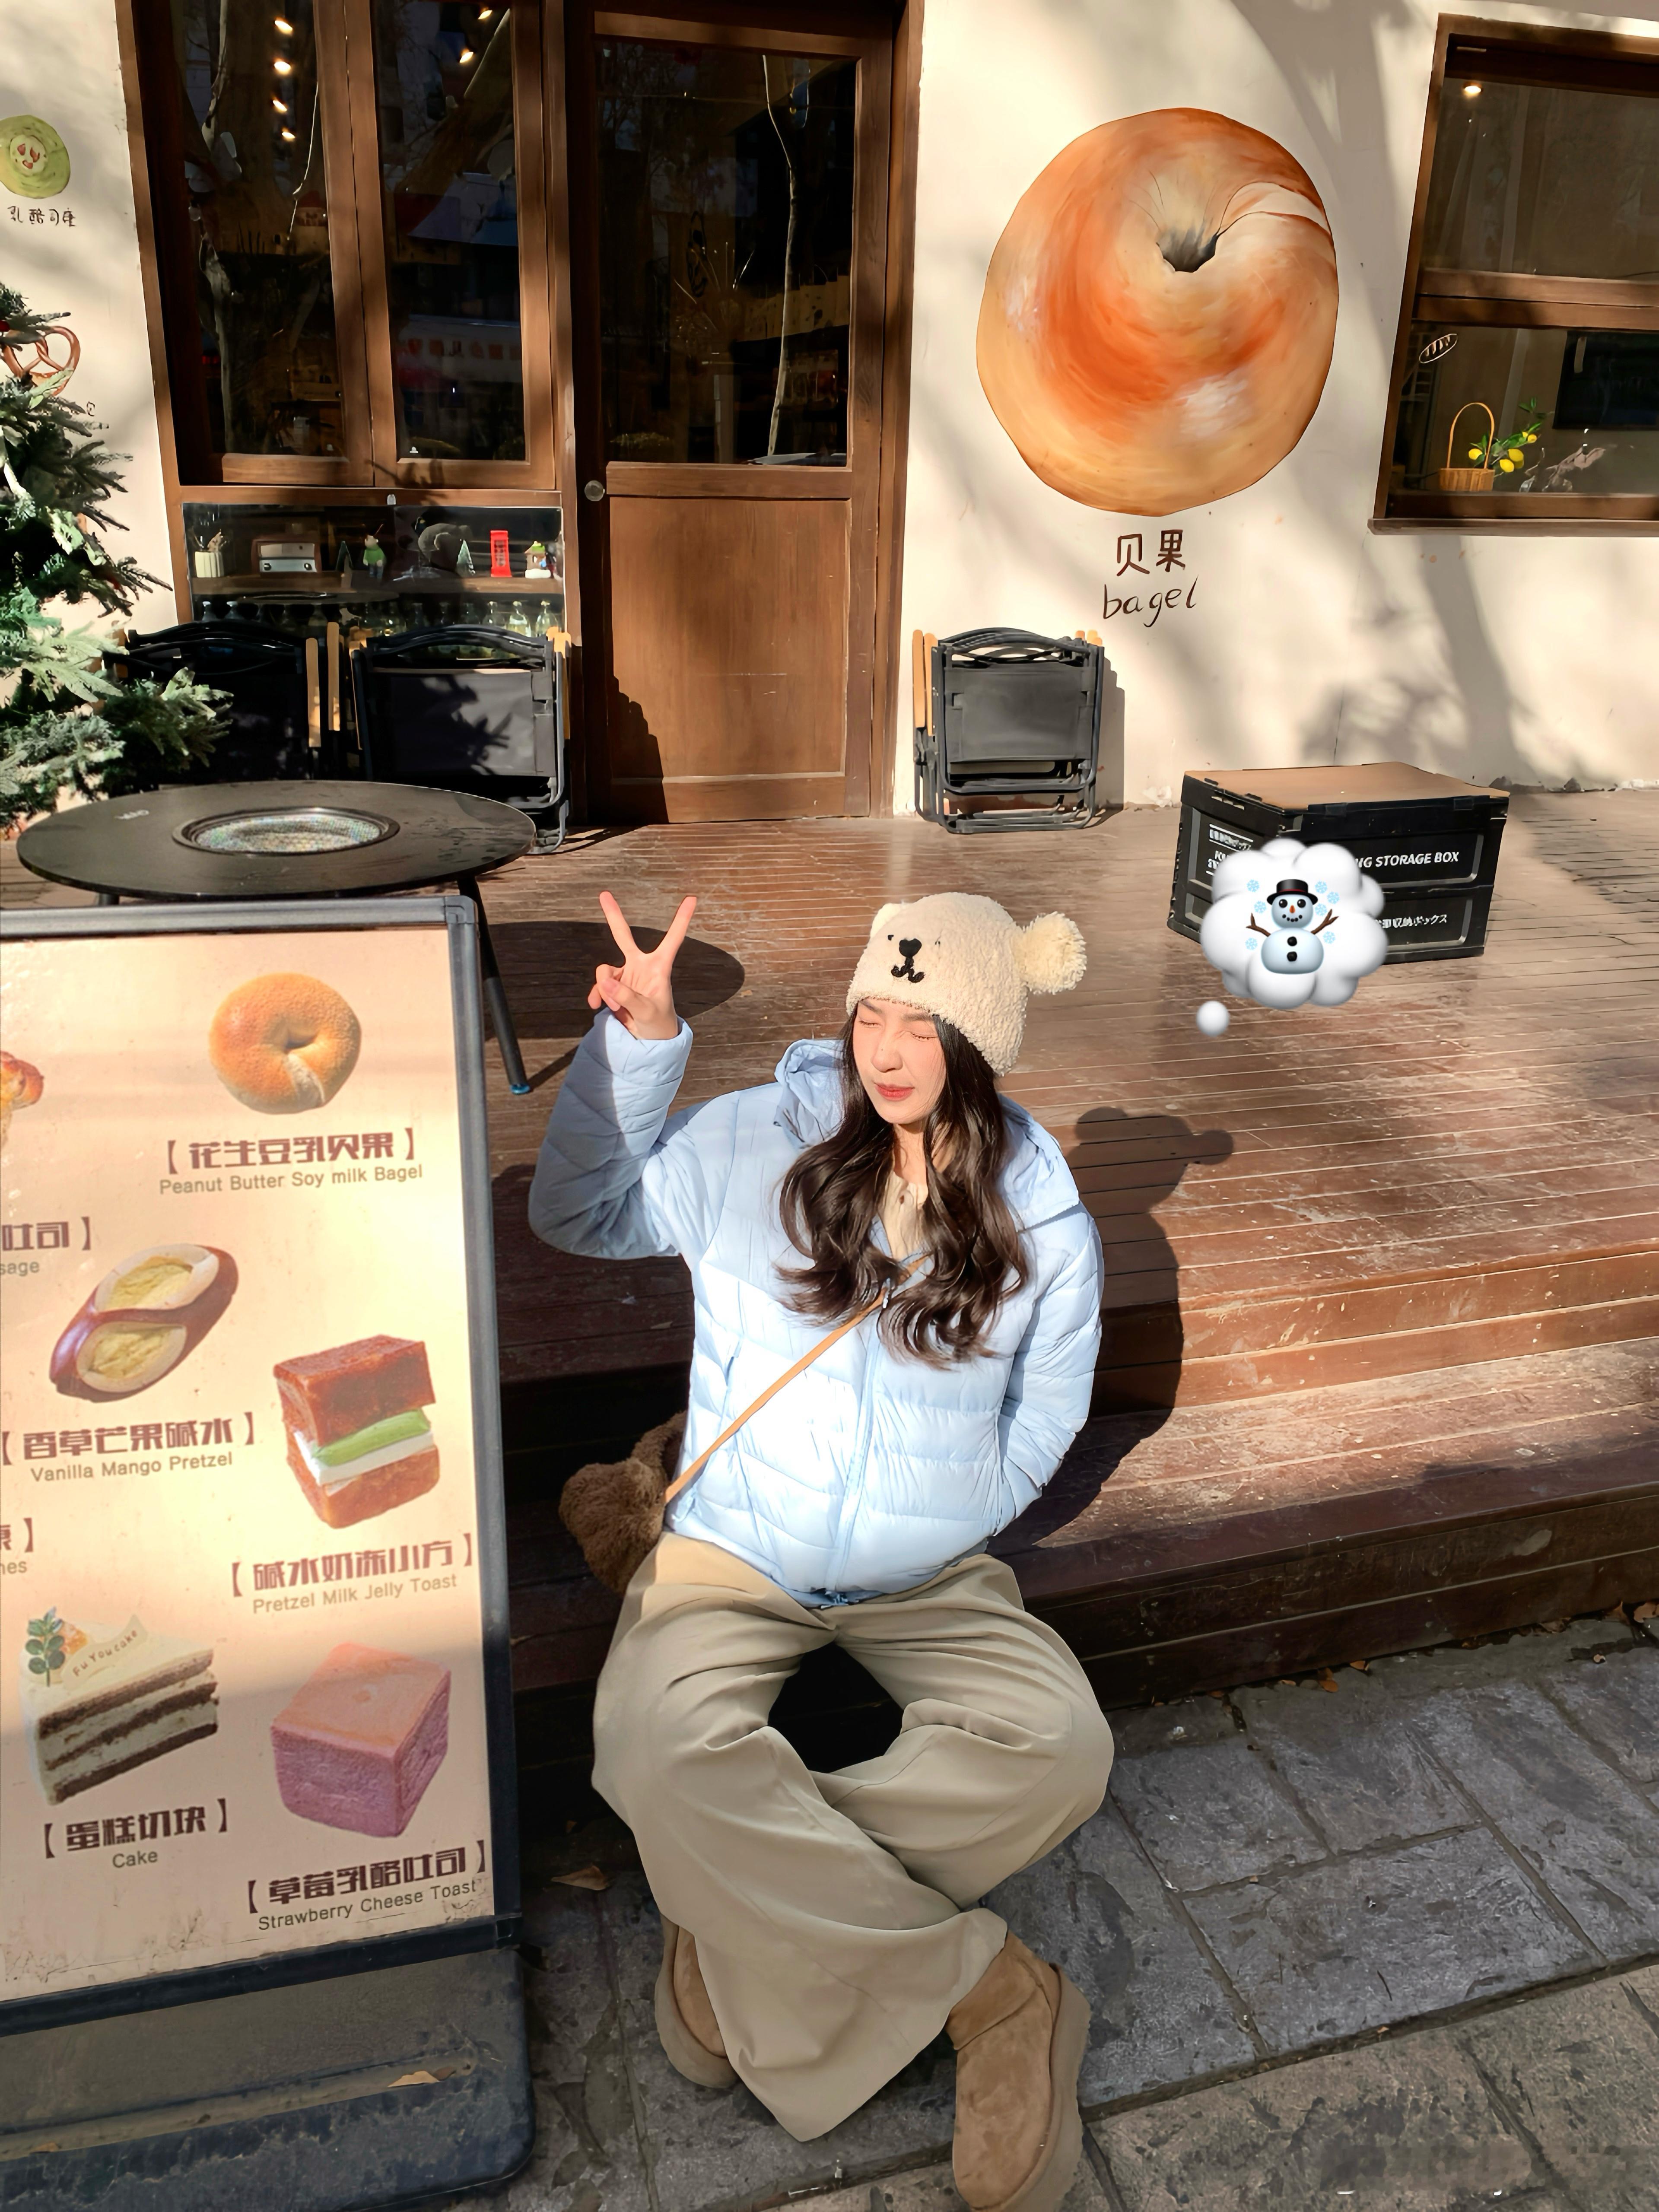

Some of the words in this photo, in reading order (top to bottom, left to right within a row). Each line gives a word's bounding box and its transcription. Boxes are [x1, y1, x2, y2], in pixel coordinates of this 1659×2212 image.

[1116, 529, 1185, 576] 贝果
[1103, 574, 1198, 627] bagel
[1376, 853, 1432, 867] STORAGE
[1434, 852, 1459, 863] BOX
[160, 1177, 222, 1195] Peanut
[230, 1174, 285, 1191] Butter
[292, 1171, 324, 1188] Soy
[332, 1168, 367, 1184] milk
[375, 1164, 422, 1182] Bagel
[30, 1464, 93, 1482] Vanilla
[102, 1461, 162, 1476] Mango
[169, 1451, 232, 1471] Pretzel
[253, 1592, 315, 1614] Pretzel
[323, 1587, 358, 1605] Milk
[365, 1582, 403, 1599] Jelly
[410, 1573, 457, 1592] Toast
[112, 1851, 158, 1868] Cake
[259, 1904, 353, 1930] Strawberry
[361, 1891, 423, 1912] Cheese
[430, 1879, 477, 1900] Toast
